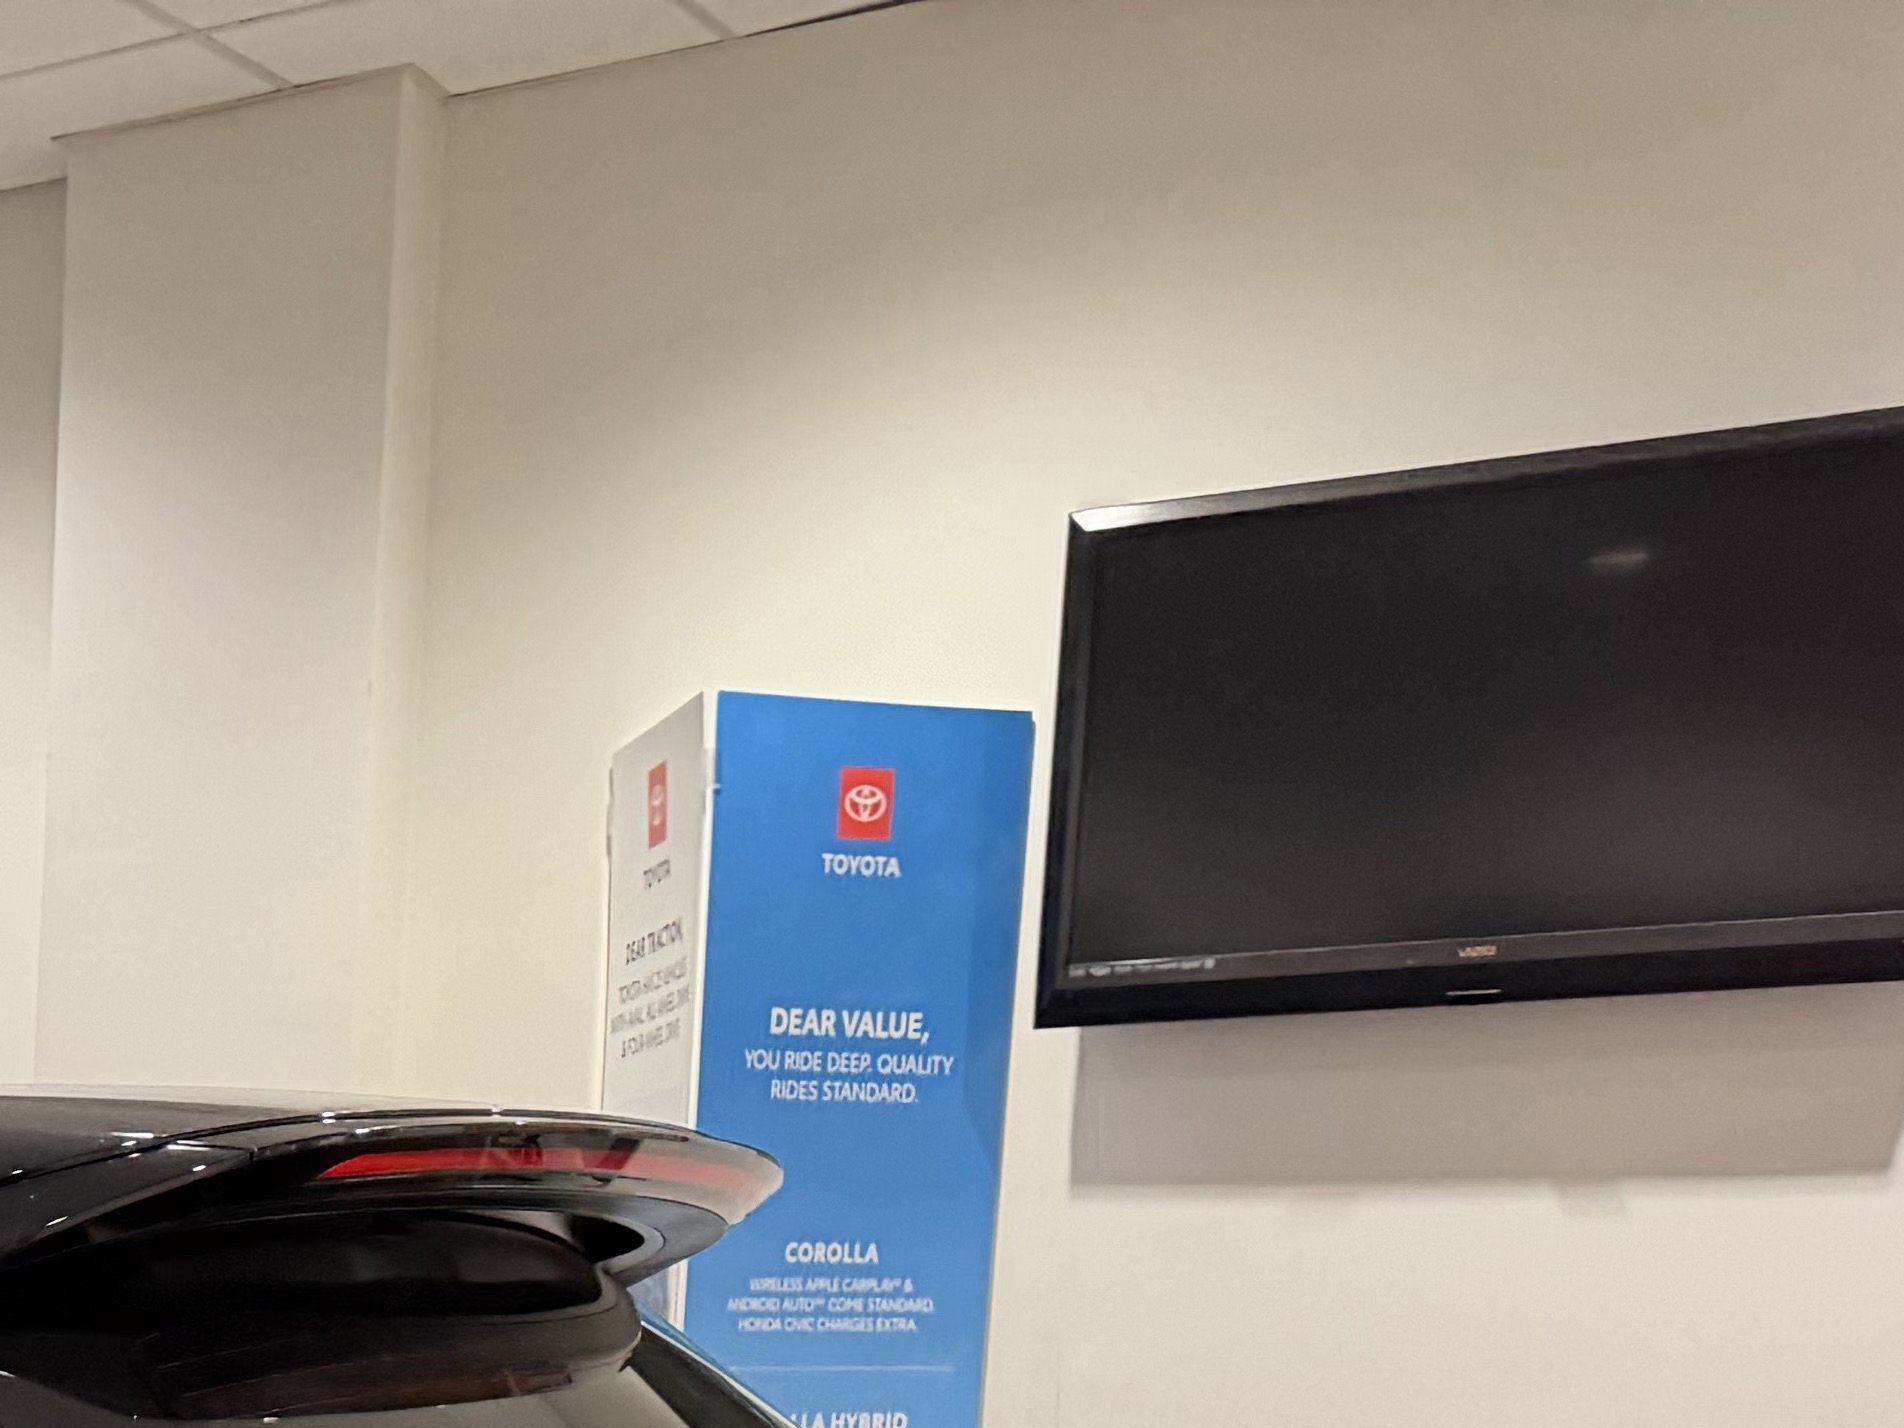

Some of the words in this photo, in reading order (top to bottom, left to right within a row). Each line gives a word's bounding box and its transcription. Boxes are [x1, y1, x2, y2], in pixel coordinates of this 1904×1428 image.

[821, 853, 902, 879] TOYOTA
[769, 1007, 837, 1037] DEAR
[841, 1010, 930, 1046] VALUE,
[745, 1048, 780, 1071] YOU
[784, 1051, 823, 1072] RIDE
[827, 1052, 873, 1074] DEEP.
[876, 1054, 954, 1076] QUALITY
[770, 1079, 818, 1101] RIDES
[822, 1081, 920, 1105] STANDARD.
[784, 1241, 880, 1265] COROLLA
[805, 1277, 840, 1293] APPLE
[726, 1297, 780, 1313] ANDROID
[738, 1317, 782, 1332] HONDA
